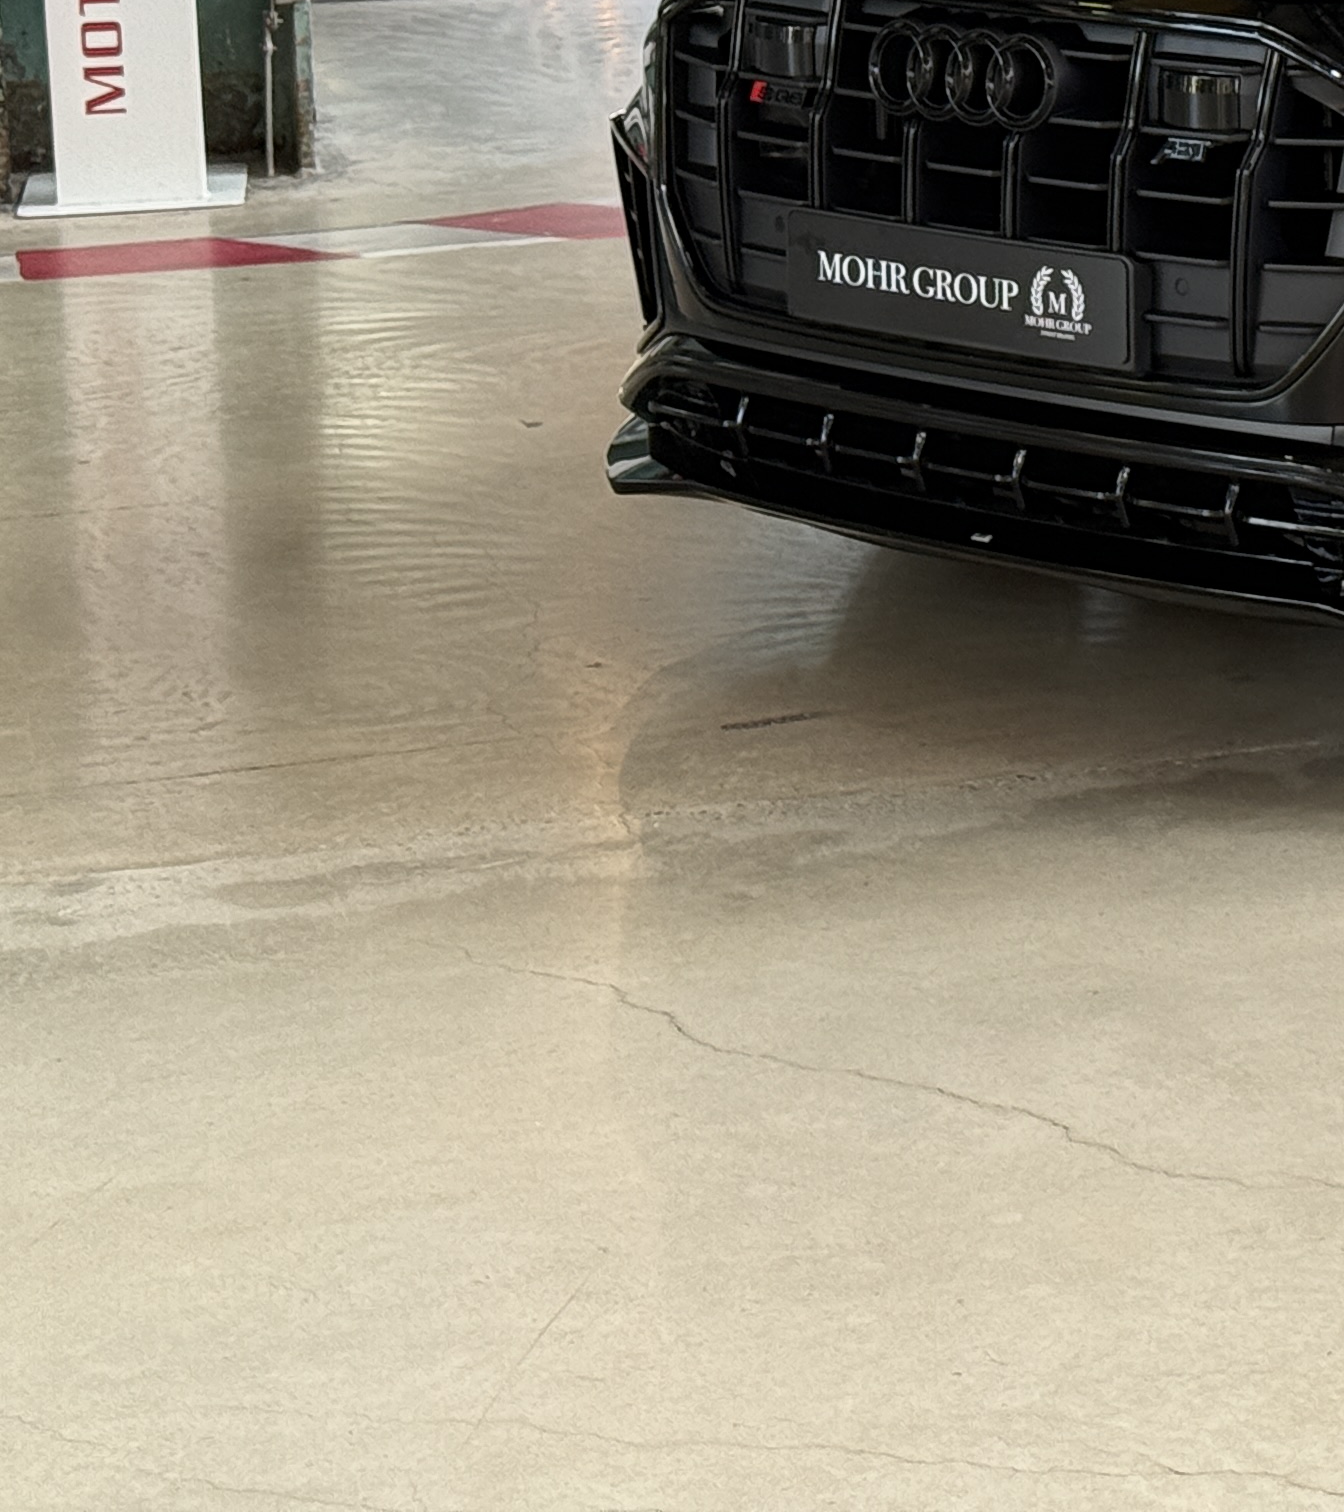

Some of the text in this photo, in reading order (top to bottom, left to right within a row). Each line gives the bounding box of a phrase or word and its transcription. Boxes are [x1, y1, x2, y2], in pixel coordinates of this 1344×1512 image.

[816, 250, 1020, 312] MOHR GROUP
[1024, 313, 1056, 330] MOHR
[1055, 319, 1093, 336] GROUP
